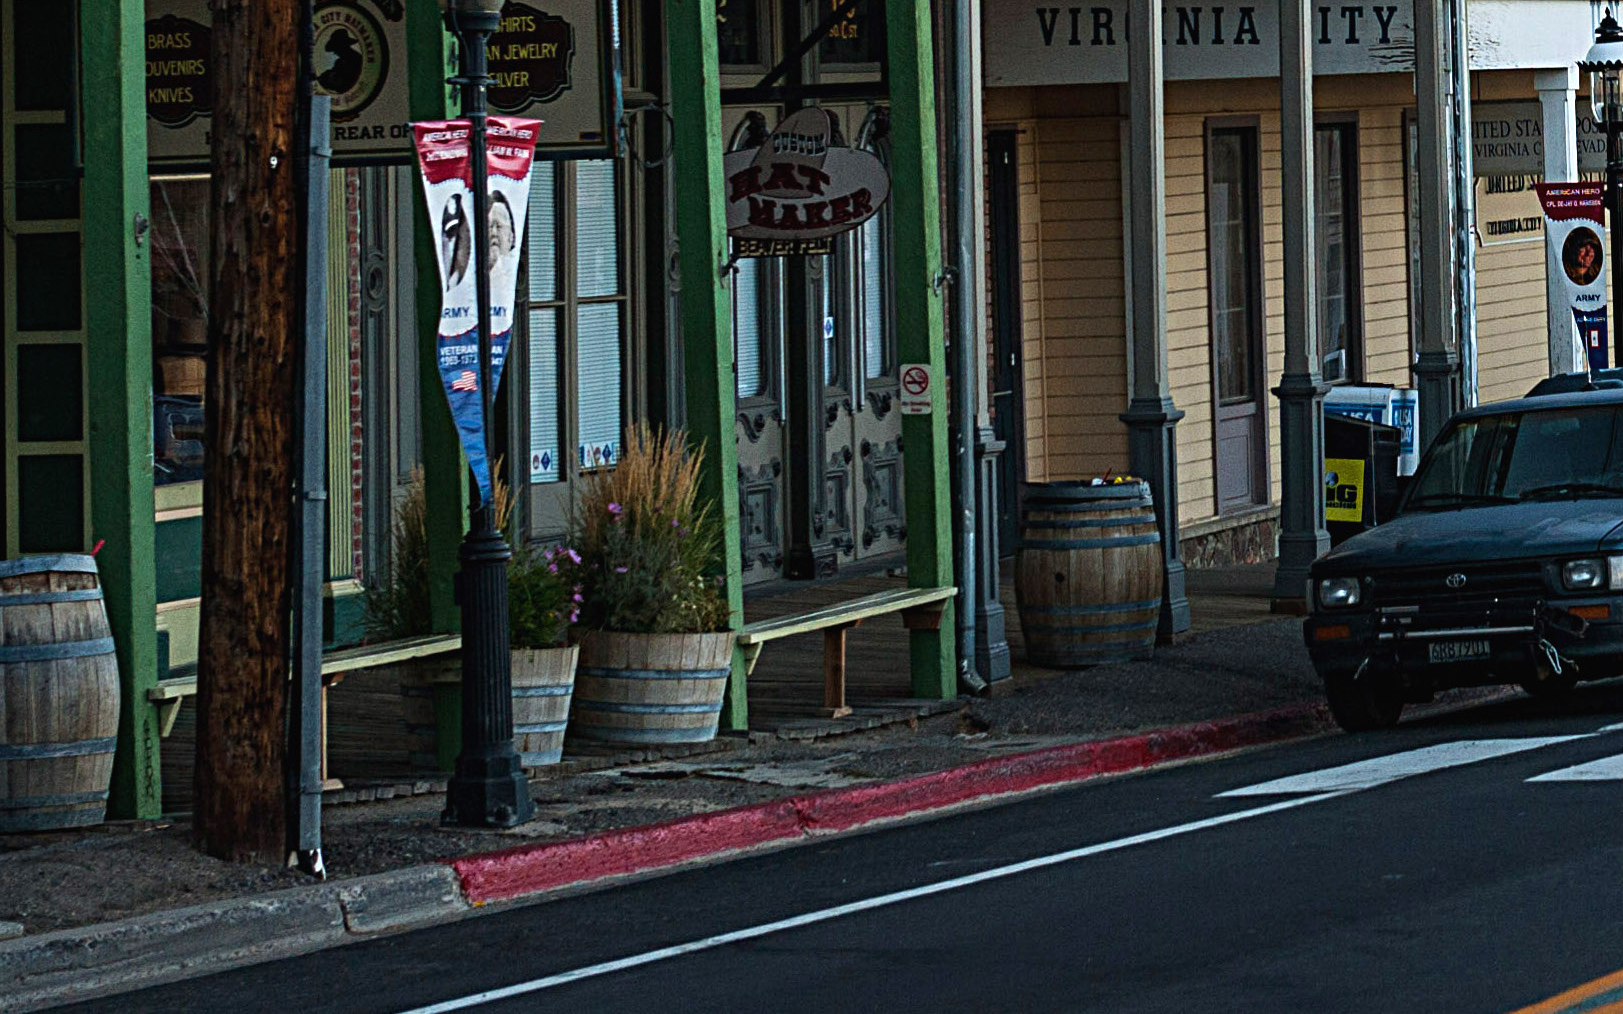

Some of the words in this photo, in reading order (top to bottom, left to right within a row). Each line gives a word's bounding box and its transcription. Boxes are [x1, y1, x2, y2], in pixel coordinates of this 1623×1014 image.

[1036, 6, 1260, 46] VIRNIA
[1318, 6, 1398, 46] ITY
[148, 32, 192, 48] BRASS
[503, 43, 558, 60] JEWELRY
[145, 59, 206, 76] OUVENIRS
[149, 87, 193, 103] KNIVES
[334, 125, 388, 141] REAR
[1515, 119, 1542, 137] STA
[772, 132, 827, 156] CUSTOM
[1475, 142, 1530, 158] VIRGINIA
[728, 162, 830, 204] HAT
[1546, 188, 1580, 197] AMERICAN
[1581, 188, 1601, 196] HERO
[747, 187, 873, 230] MAKER
[737, 240, 795, 256] BEAVER
[797, 237, 833, 254] FELT
[1575, 293, 1601, 302] ARMY
[443, 306, 471, 319] RMY
